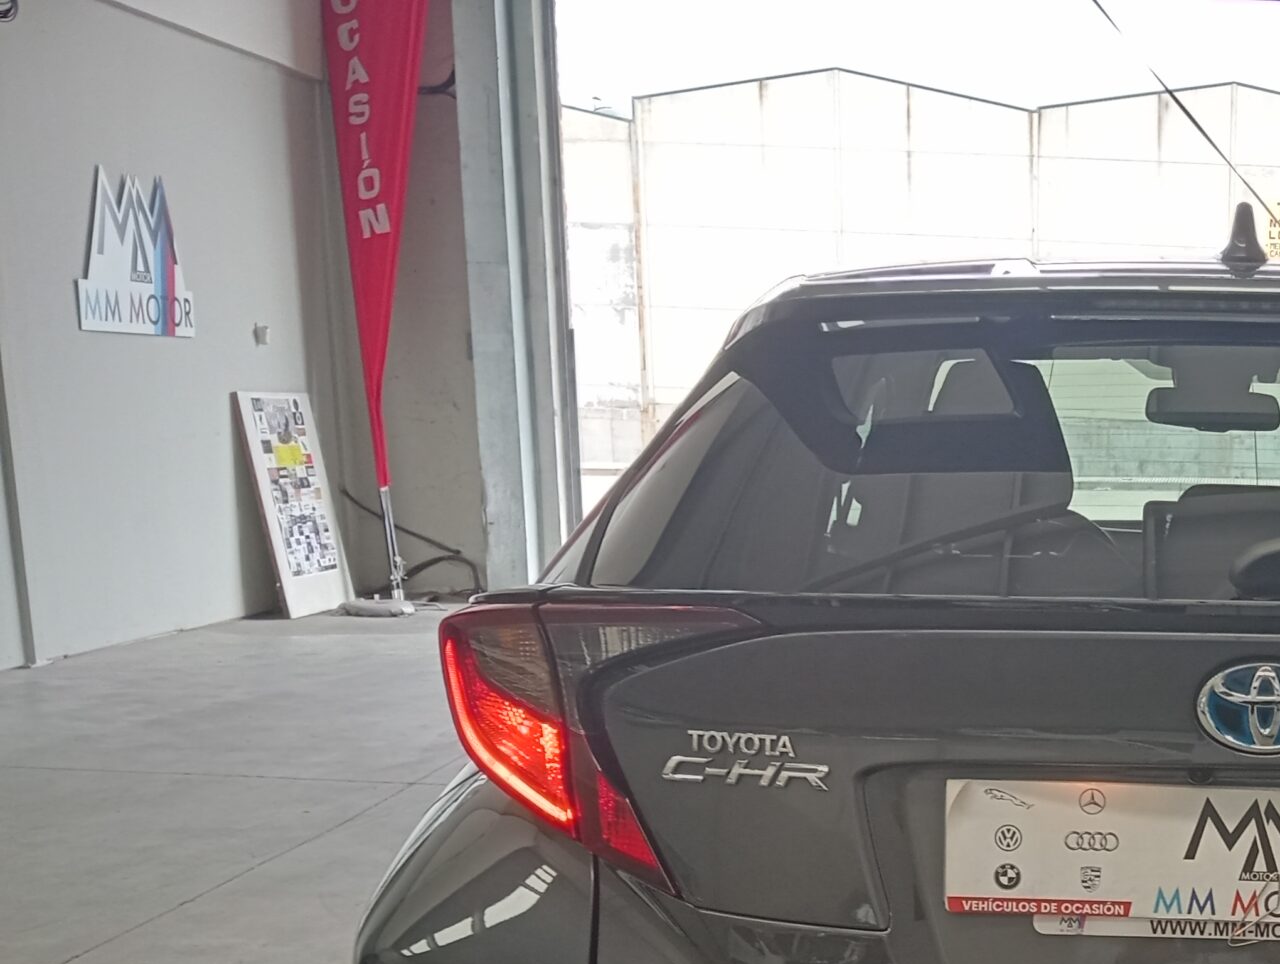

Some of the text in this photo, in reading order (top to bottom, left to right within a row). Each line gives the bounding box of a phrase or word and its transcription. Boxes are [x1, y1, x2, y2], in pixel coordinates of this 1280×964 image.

[129, 291, 193, 328] MOTOR
[687, 730, 795, 757] TOYOTA
[661, 755, 829, 791] C-HR
[1240, 871, 1279, 881] MOTOR
[962, 898, 1124, 915] VEHÍCULOS DE OCASIÓN
